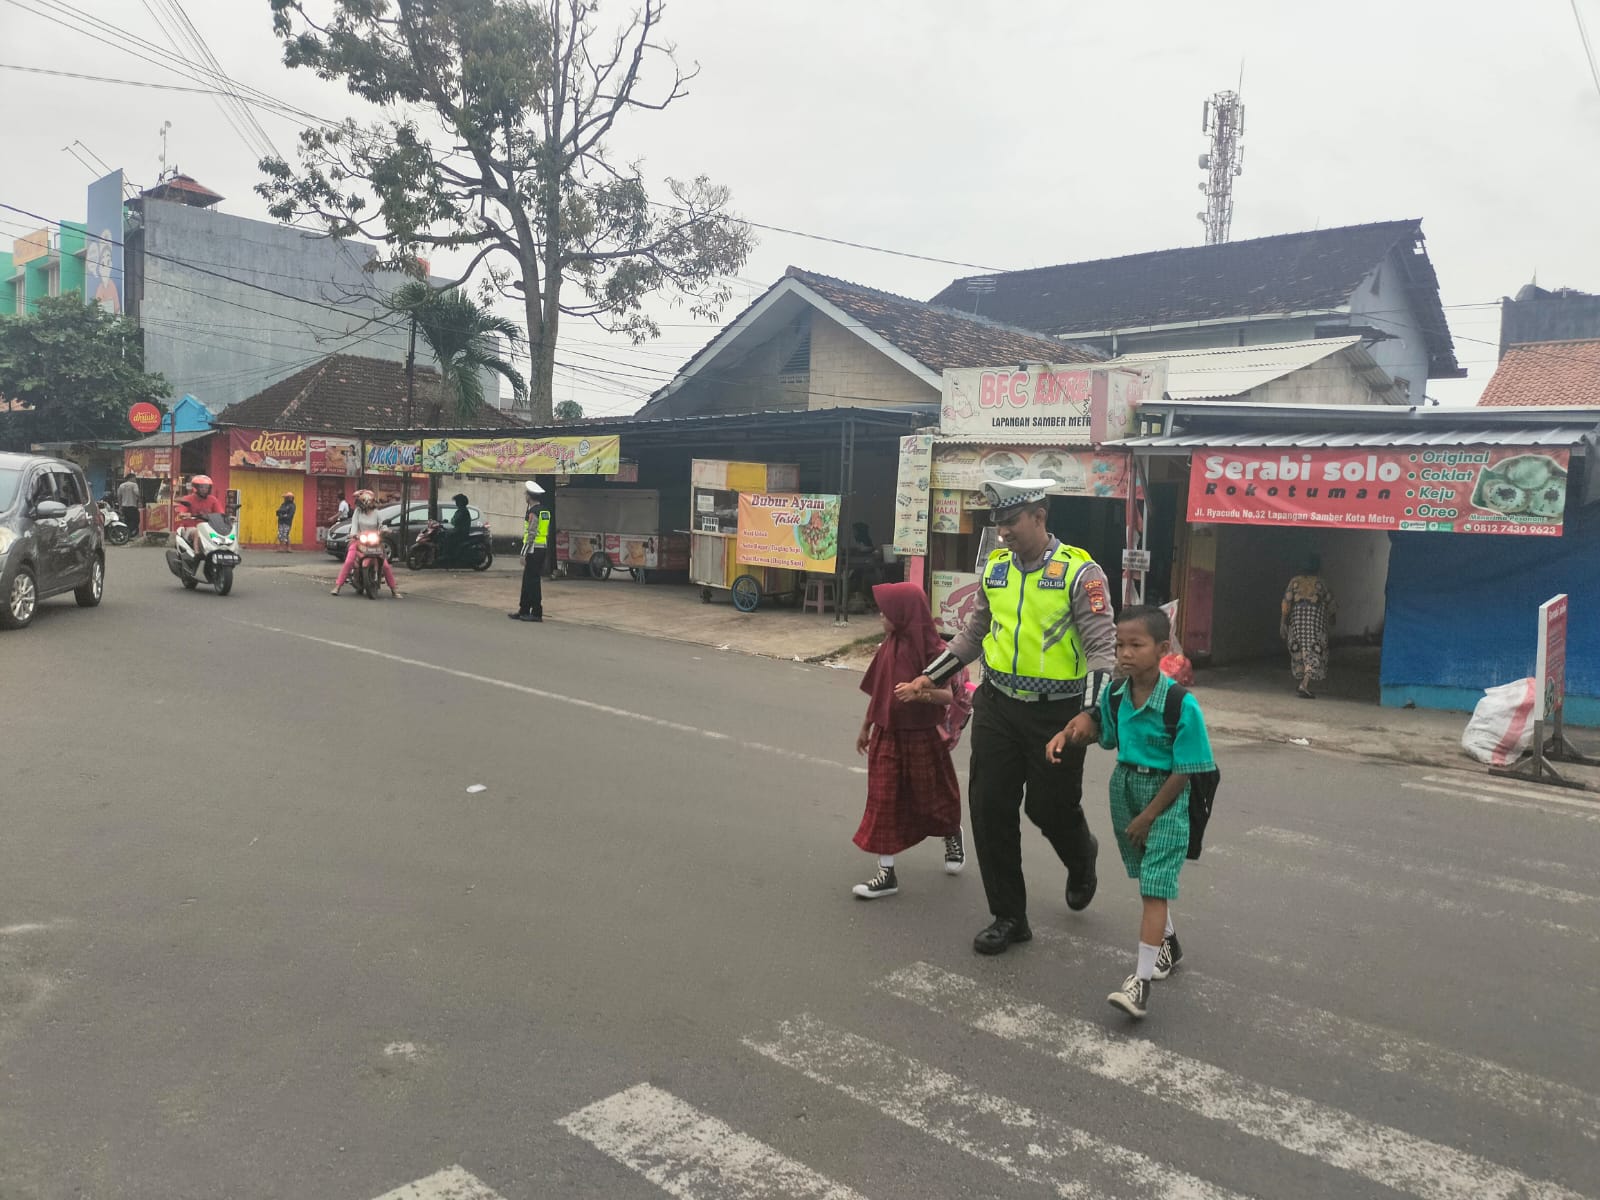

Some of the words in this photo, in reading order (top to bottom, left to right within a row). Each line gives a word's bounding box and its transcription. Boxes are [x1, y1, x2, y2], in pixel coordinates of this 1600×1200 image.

[979, 370, 1030, 409] BFC
[1033, 369, 1091, 405] EXPRE
[992, 416, 1030, 428] LAPANGAN
[1032, 416, 1066, 427] SAMBER
[1068, 416, 1091, 427] METR
[250, 430, 306, 452] dkriuk
[1422, 450, 1490, 466] Original
[1204, 454, 1311, 481] Serabi
[1322, 455, 1401, 482] solo
[1420, 468, 1473, 482] Coklat
[1205, 483, 1391, 500] Rokotuman
[1418, 486, 1455, 503] Keju
[751, 494, 788, 508] Bubur
[790, 496, 826, 510] Ayam
[772, 512, 801, 526] Tasik
[1194, 508, 1204, 517] Jl.
[1207, 508, 1240, 519] Ryacudu
[1242, 509, 1265, 519] No.32
[1268, 510, 1308, 521] Lapangan
[1310, 511, 1343, 522] Samber
[1346, 512, 1365, 523] Kota
[1368, 513, 1395, 524] Metro
[1417, 504, 1458, 518] Oreo
[1473, 524, 1498, 532] 0812
[1500, 525, 1527, 533] 7430
[1529, 525, 1556, 534] 9623
[1039, 580, 1065, 588] POLISI
